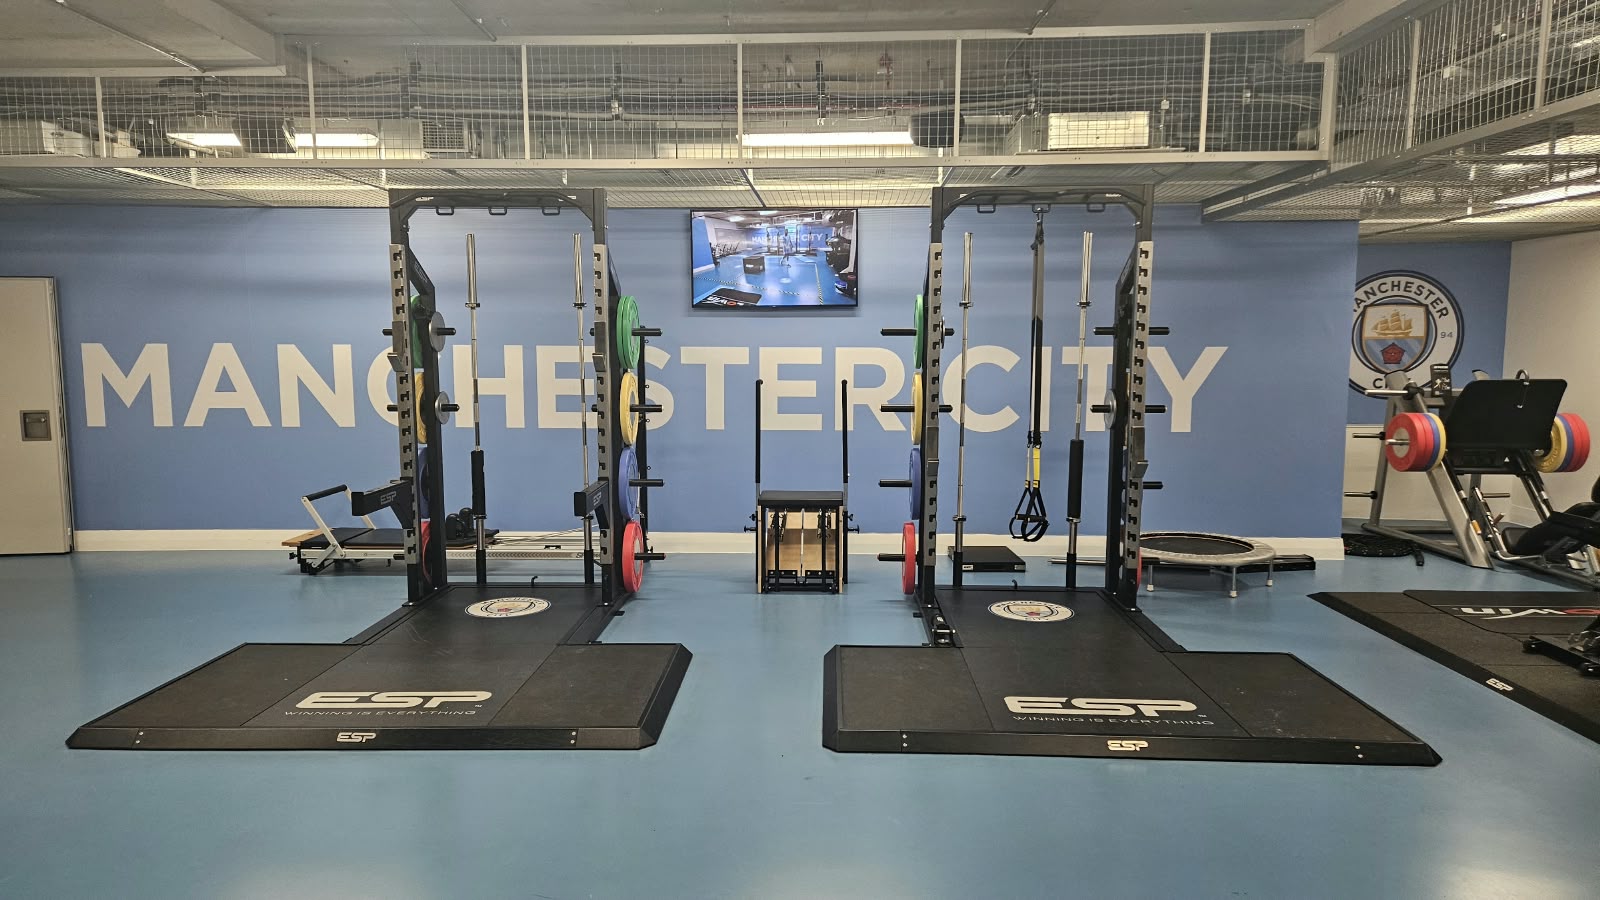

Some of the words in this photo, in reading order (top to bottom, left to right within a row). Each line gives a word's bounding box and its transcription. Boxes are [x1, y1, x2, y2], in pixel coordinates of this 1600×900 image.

[1353, 280, 1449, 320] ANCHESTER
[1440, 331, 1453, 339] 94
[942, 345, 1229, 433] CITY
[380, 491, 397, 505] ESP
[1486, 678, 1514, 691] ESP
[295, 690, 492, 709] ESP
[1003, 696, 1197, 716] ESP
[336, 732, 377, 743] ESP
[1106, 740, 1149, 751] ESP
